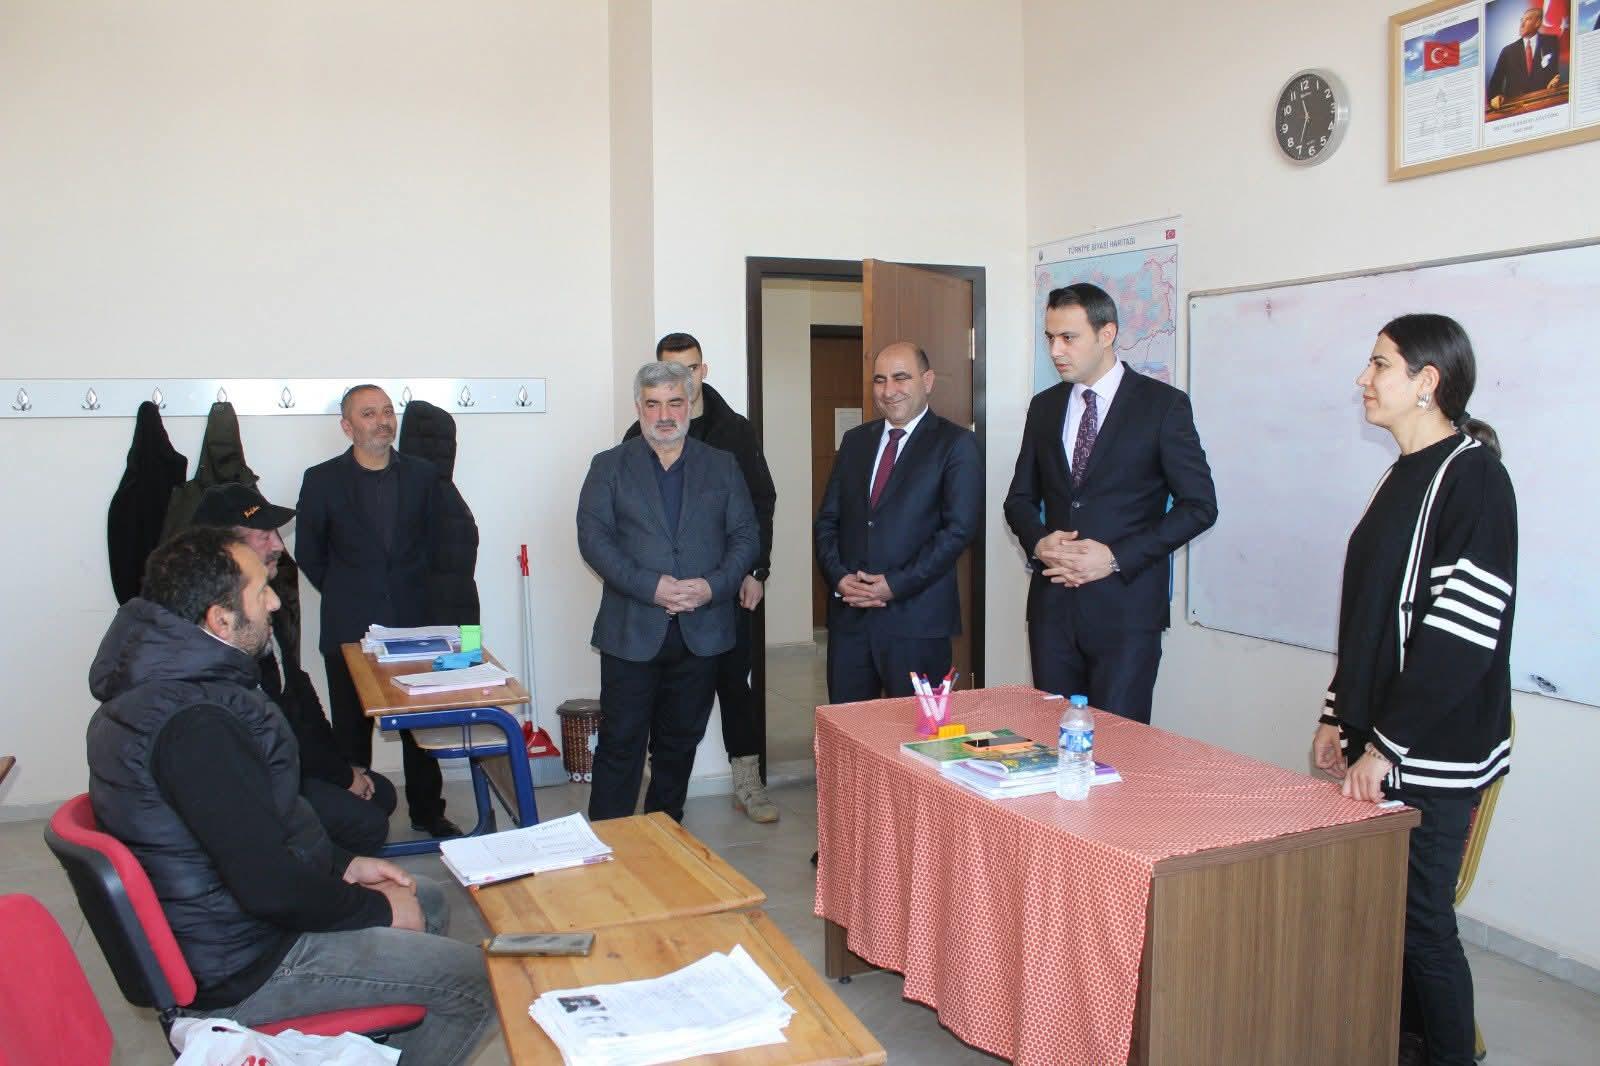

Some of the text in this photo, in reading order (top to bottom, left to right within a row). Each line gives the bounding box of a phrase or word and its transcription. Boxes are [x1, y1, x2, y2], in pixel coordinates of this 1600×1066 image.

[1300, 80, 1310, 91] 12
[1290, 90, 1297, 101] 11
[1324, 88, 1332, 99] 2
[1283, 105, 1292, 116] 10
[1330, 102, 1336, 114] 3
[1281, 123, 1289, 134] 9
[1327, 121, 1335, 131] 4
[1287, 137, 1294, 148] 8
[1320, 135, 1327, 146] 5
[1296, 145, 1303, 155] 7
[1308, 146, 1316, 156] 6
